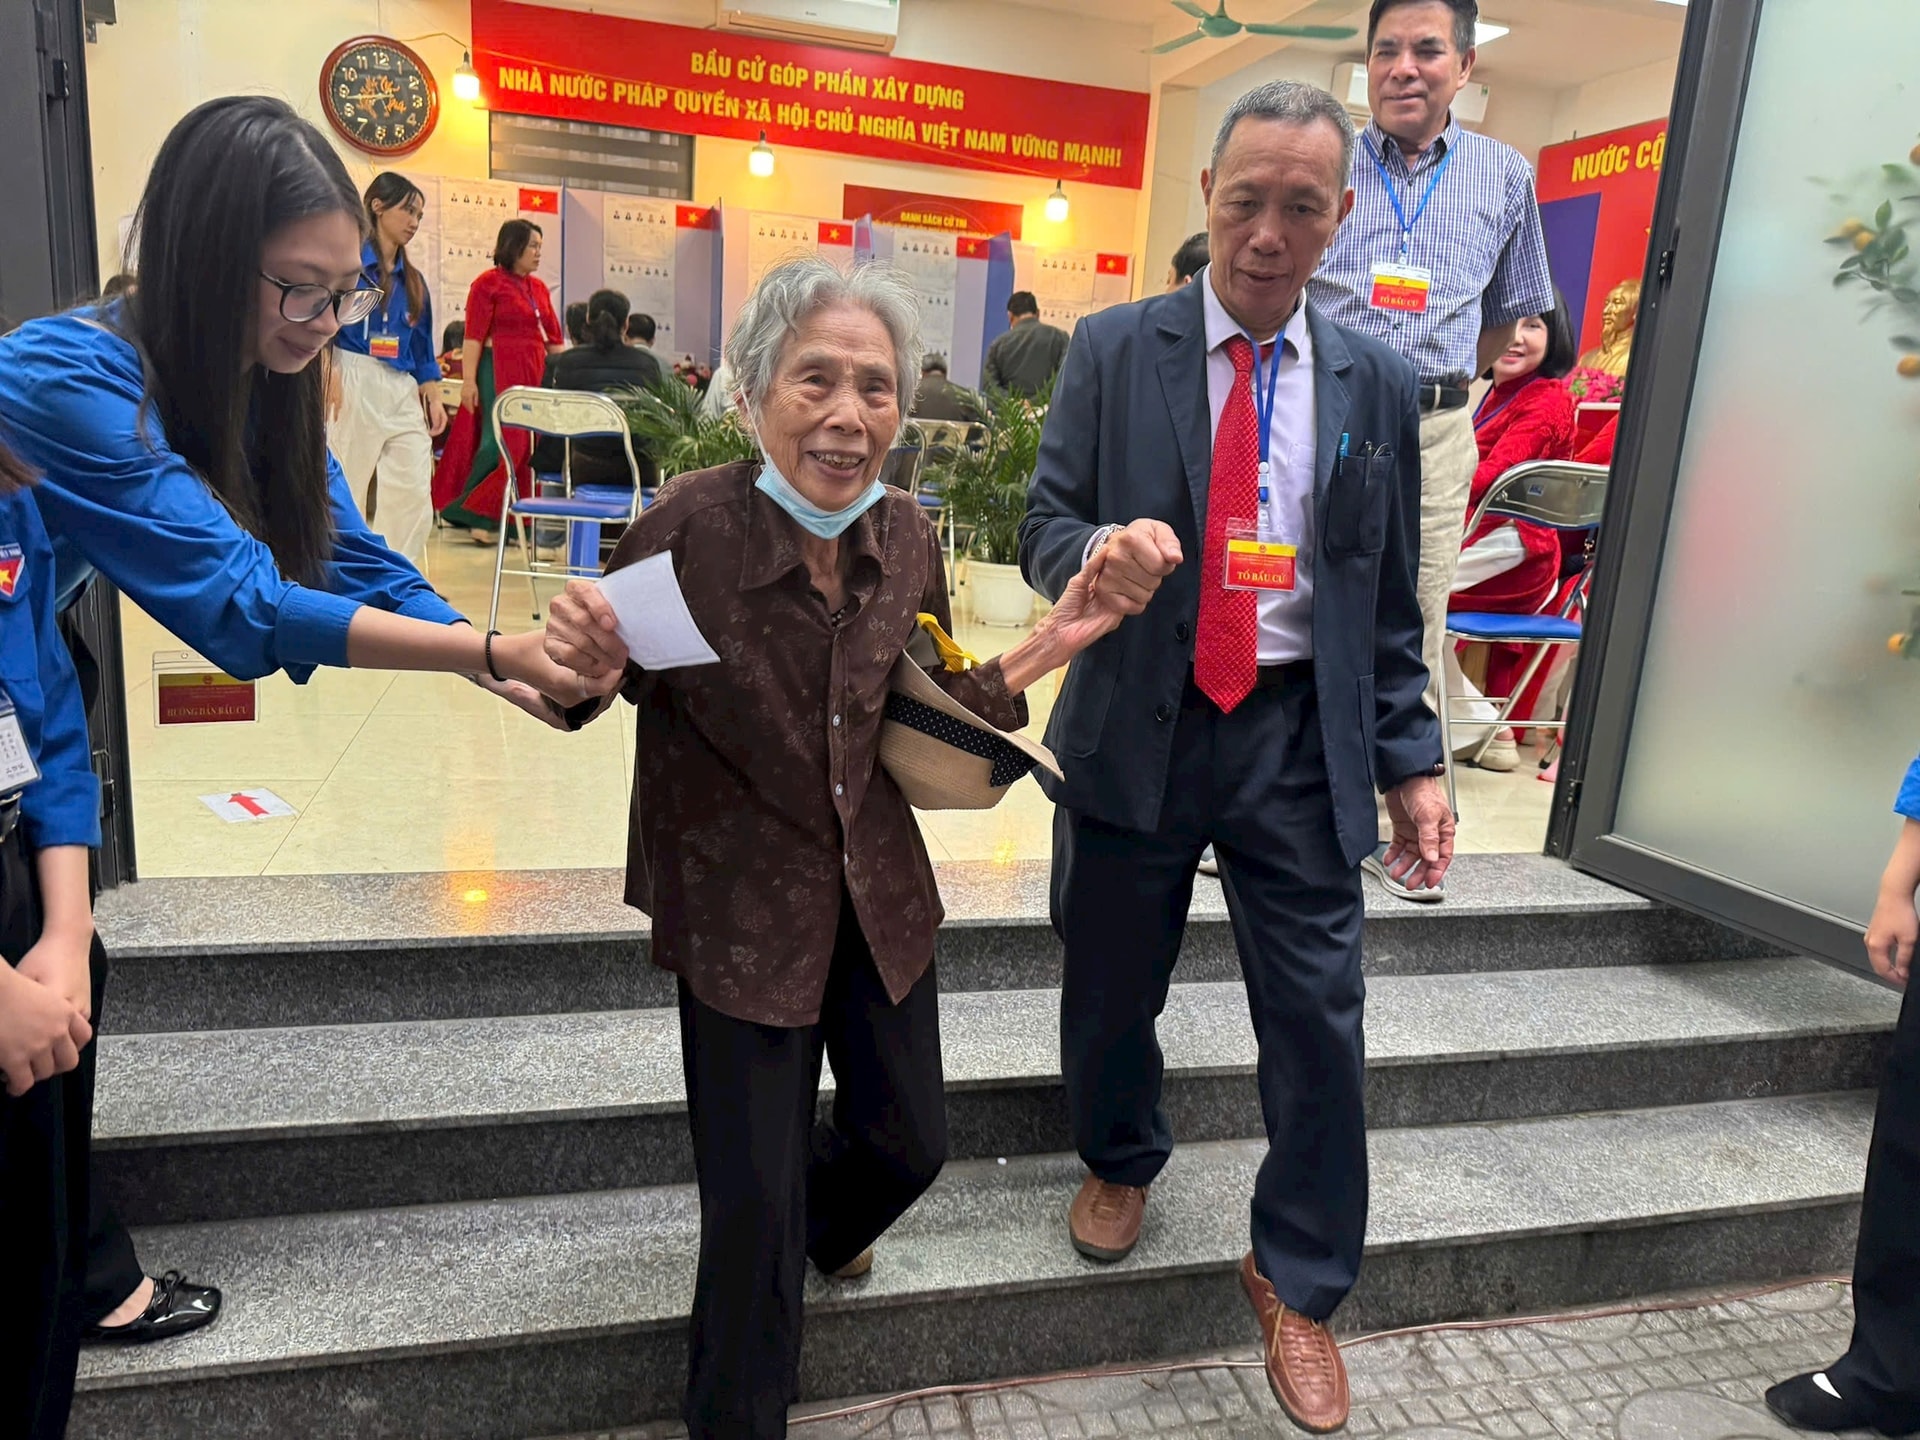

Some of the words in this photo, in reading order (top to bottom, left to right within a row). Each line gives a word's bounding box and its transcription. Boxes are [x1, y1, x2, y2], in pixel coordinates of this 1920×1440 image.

[357, 55, 368, 70] 11
[373, 52, 391, 68] 12
[342, 67, 358, 81] 10
[397, 61, 403, 75] 1
[409, 75, 419, 90] 2
[691, 48, 731, 78] BẦU
[737, 55, 766, 81] CỬ
[770, 61, 808, 88] GÓP
[814, 68, 866, 97] PHẦN
[872, 76, 909, 103] XÂY
[914, 83, 964, 110] DỰNG
[339, 84, 350, 98] 9
[412, 94, 423, 108] 3
[344, 103, 355, 117] 8
[498, 65, 544, 94] NHÀ
[549, 71, 607, 102] NƯỚC
[613, 81, 668, 109] PHÁP
[674, 89, 739, 118] QUYỀN
[745, 97, 772, 124] XÃ
[777, 103, 809, 132] HỘI
[814, 107, 854, 134] CHỦ
[858, 116, 916, 142] NGHĨA
[921, 121, 960, 150] VIỆT
[964, 128, 1006, 154] NAM
[1011, 133, 1058, 161] VỮNG
[1064, 142, 1122, 168] MẠNH!
[355, 118, 368, 136] 7
[407, 113, 417, 126] 4
[375, 126, 386, 140] 6
[394, 124, 405, 137] 5
[1571, 143, 1630, 183] NƯỚC
[1635, 131, 1666, 171] CỘ
[901, 211, 921, 223] DANH
[922, 213, 942, 226] SÁCH
[944, 214, 954, 227] CỬ
[1237, 569, 1250, 580] TỔ
[1252, 570, 1270, 582] BẦU
[1272, 572, 1286, 584] CỬ
